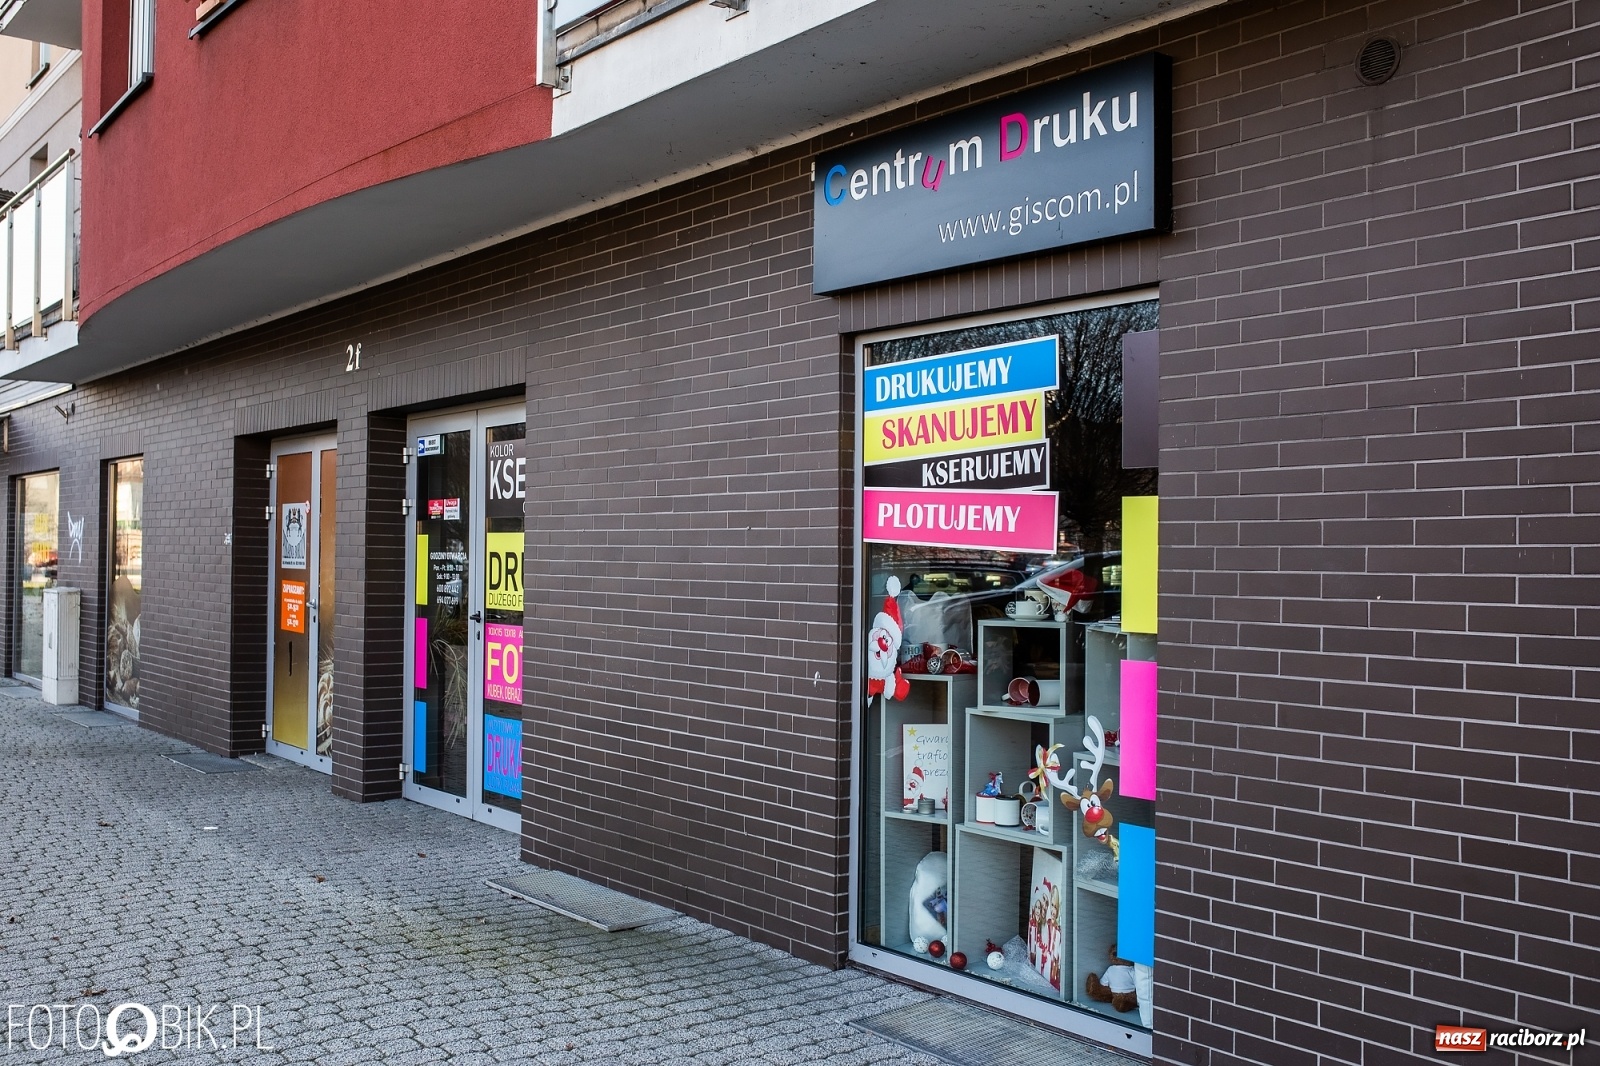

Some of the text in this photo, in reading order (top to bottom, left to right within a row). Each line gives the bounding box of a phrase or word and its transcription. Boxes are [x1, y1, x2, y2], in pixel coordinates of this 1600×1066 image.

[824, 91, 1138, 207] Centrum Druku
[938, 170, 1139, 243] www.giscom.pl
[346, 342, 362, 371] 2f
[875, 356, 1012, 402] DRUKUJEMY
[882, 399, 1037, 449] SKANUJEMY
[490, 444, 514, 457] KOLOR
[922, 447, 1045, 487] KSERUJEMY
[877, 503, 1021, 532] PLOTUJEMY
[489, 591, 517, 606] DUŻEGO
[924, 769, 948, 780] prez
